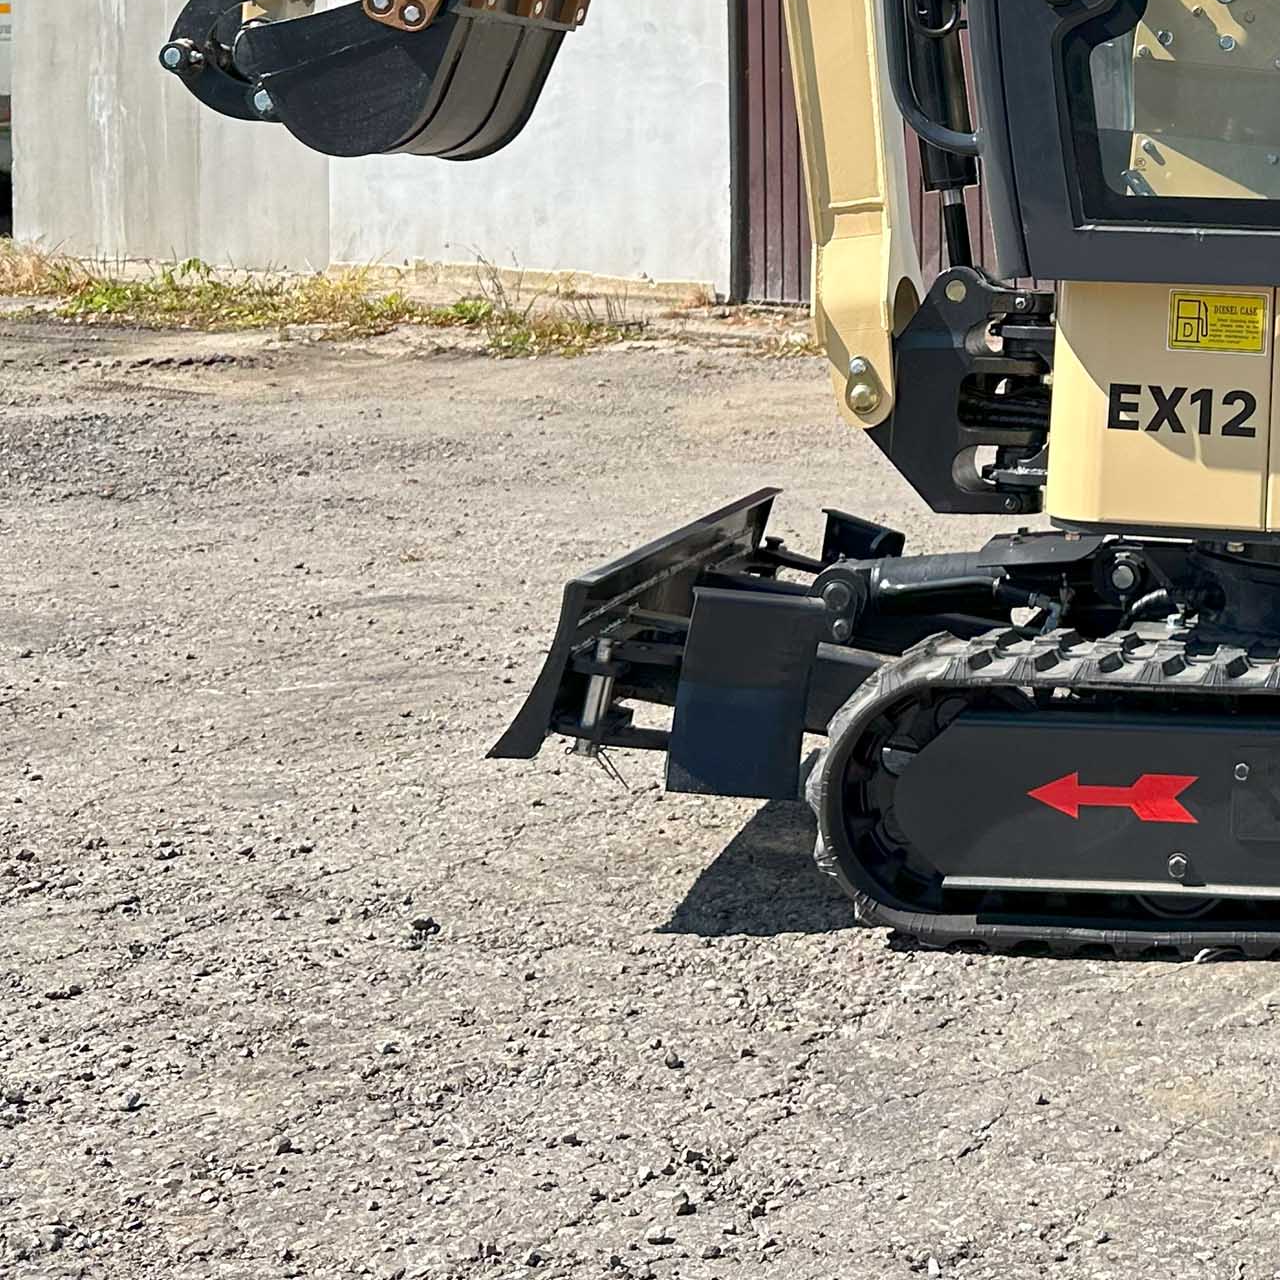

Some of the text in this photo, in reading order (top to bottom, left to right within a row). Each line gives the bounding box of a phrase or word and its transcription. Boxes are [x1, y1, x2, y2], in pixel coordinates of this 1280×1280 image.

[1213, 305, 1238, 314] DIESEL
[1183, 322, 1193, 337] D
[1107, 383, 1257, 438] EX12
